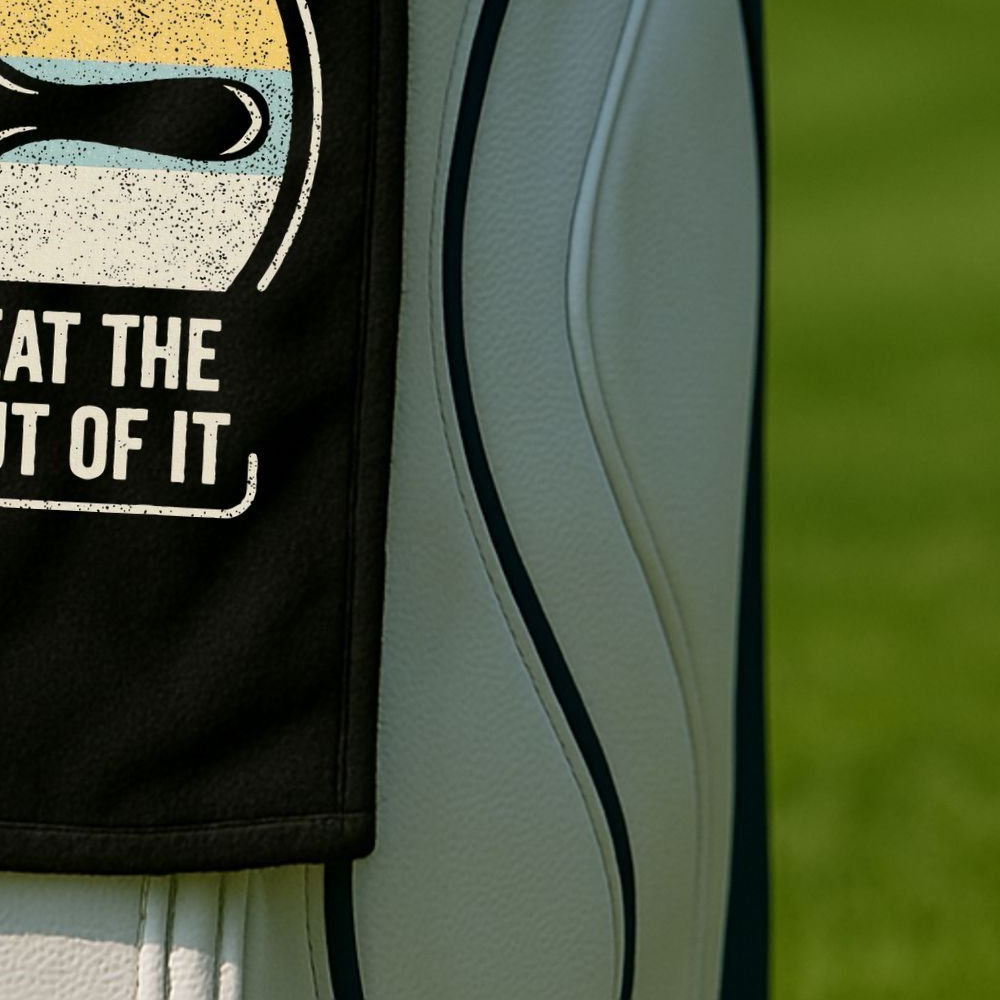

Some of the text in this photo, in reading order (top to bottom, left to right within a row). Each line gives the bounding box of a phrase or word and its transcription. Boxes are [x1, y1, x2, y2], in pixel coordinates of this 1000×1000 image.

[102, 314, 222, 391] THE
[70, 406, 148, 480] OF
[171, 411, 231, 484] IT
